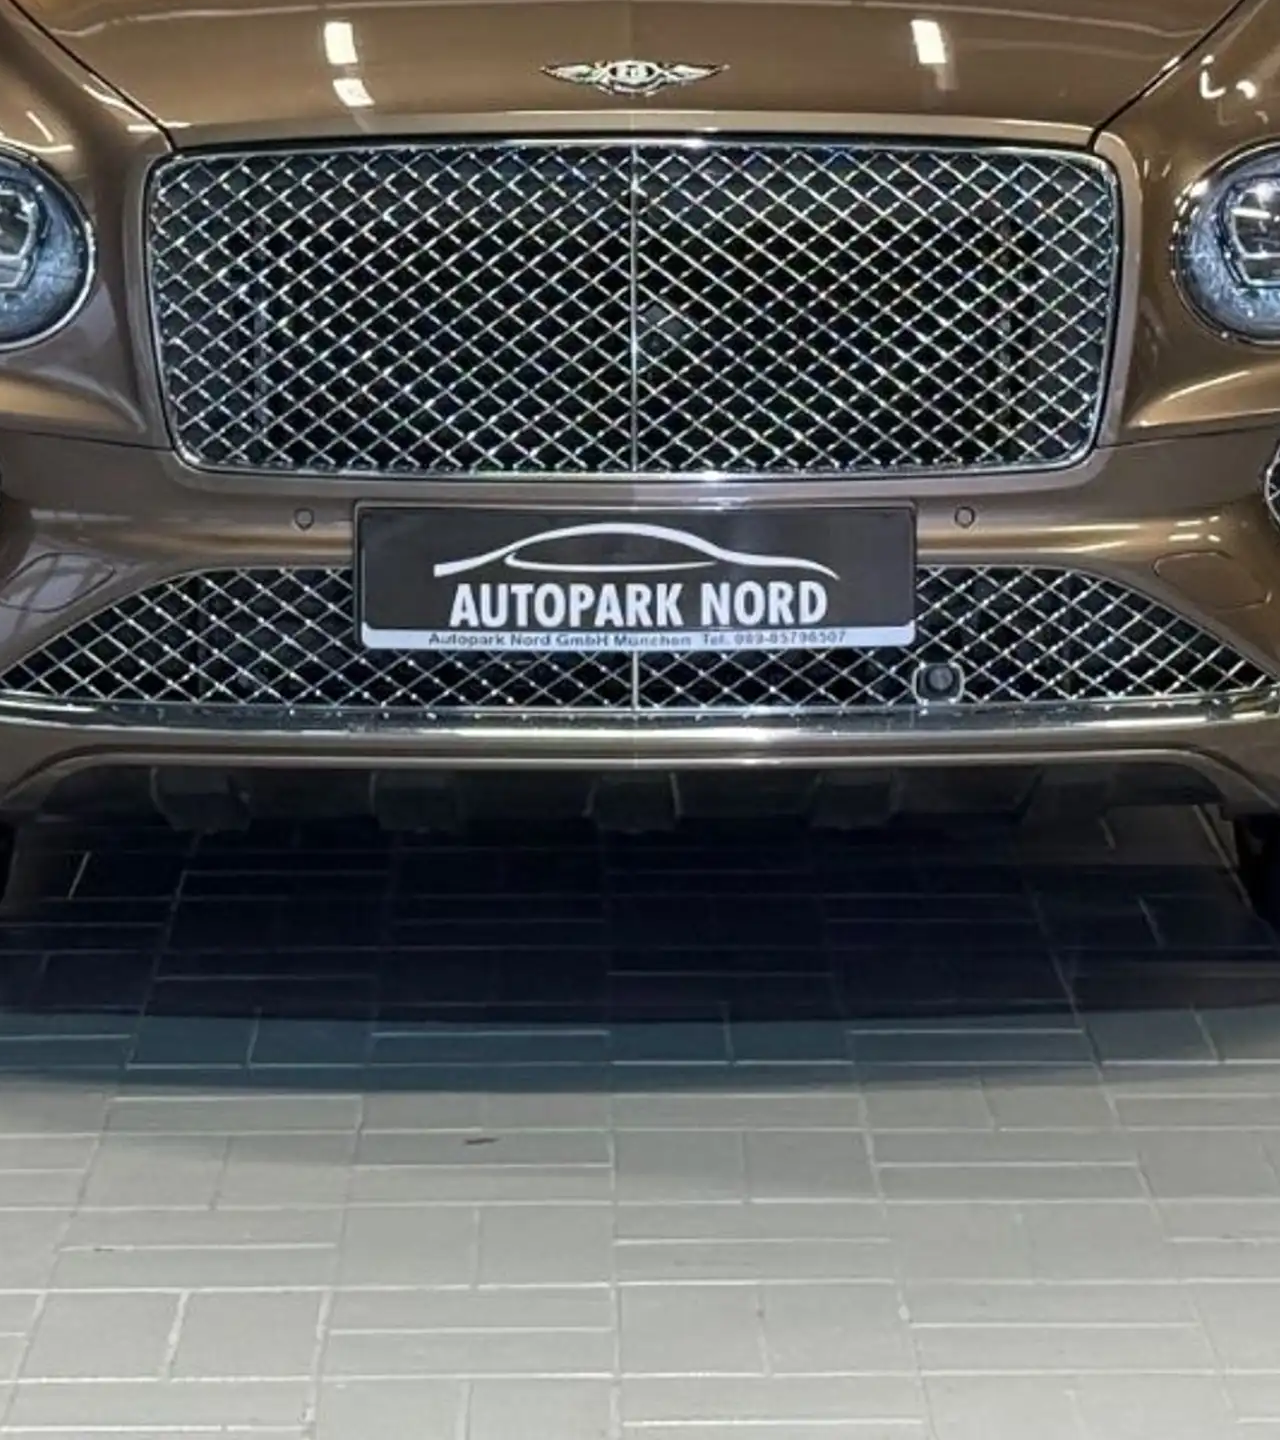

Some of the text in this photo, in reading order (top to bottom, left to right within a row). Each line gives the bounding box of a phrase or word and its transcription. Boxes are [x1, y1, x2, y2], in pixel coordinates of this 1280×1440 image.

[449, 580, 829, 628] AUTOPARK NORD
[428, 632, 505, 648] Autopark
[510, 632, 551, 647] Nord
[556, 632, 609, 647] GmbH
